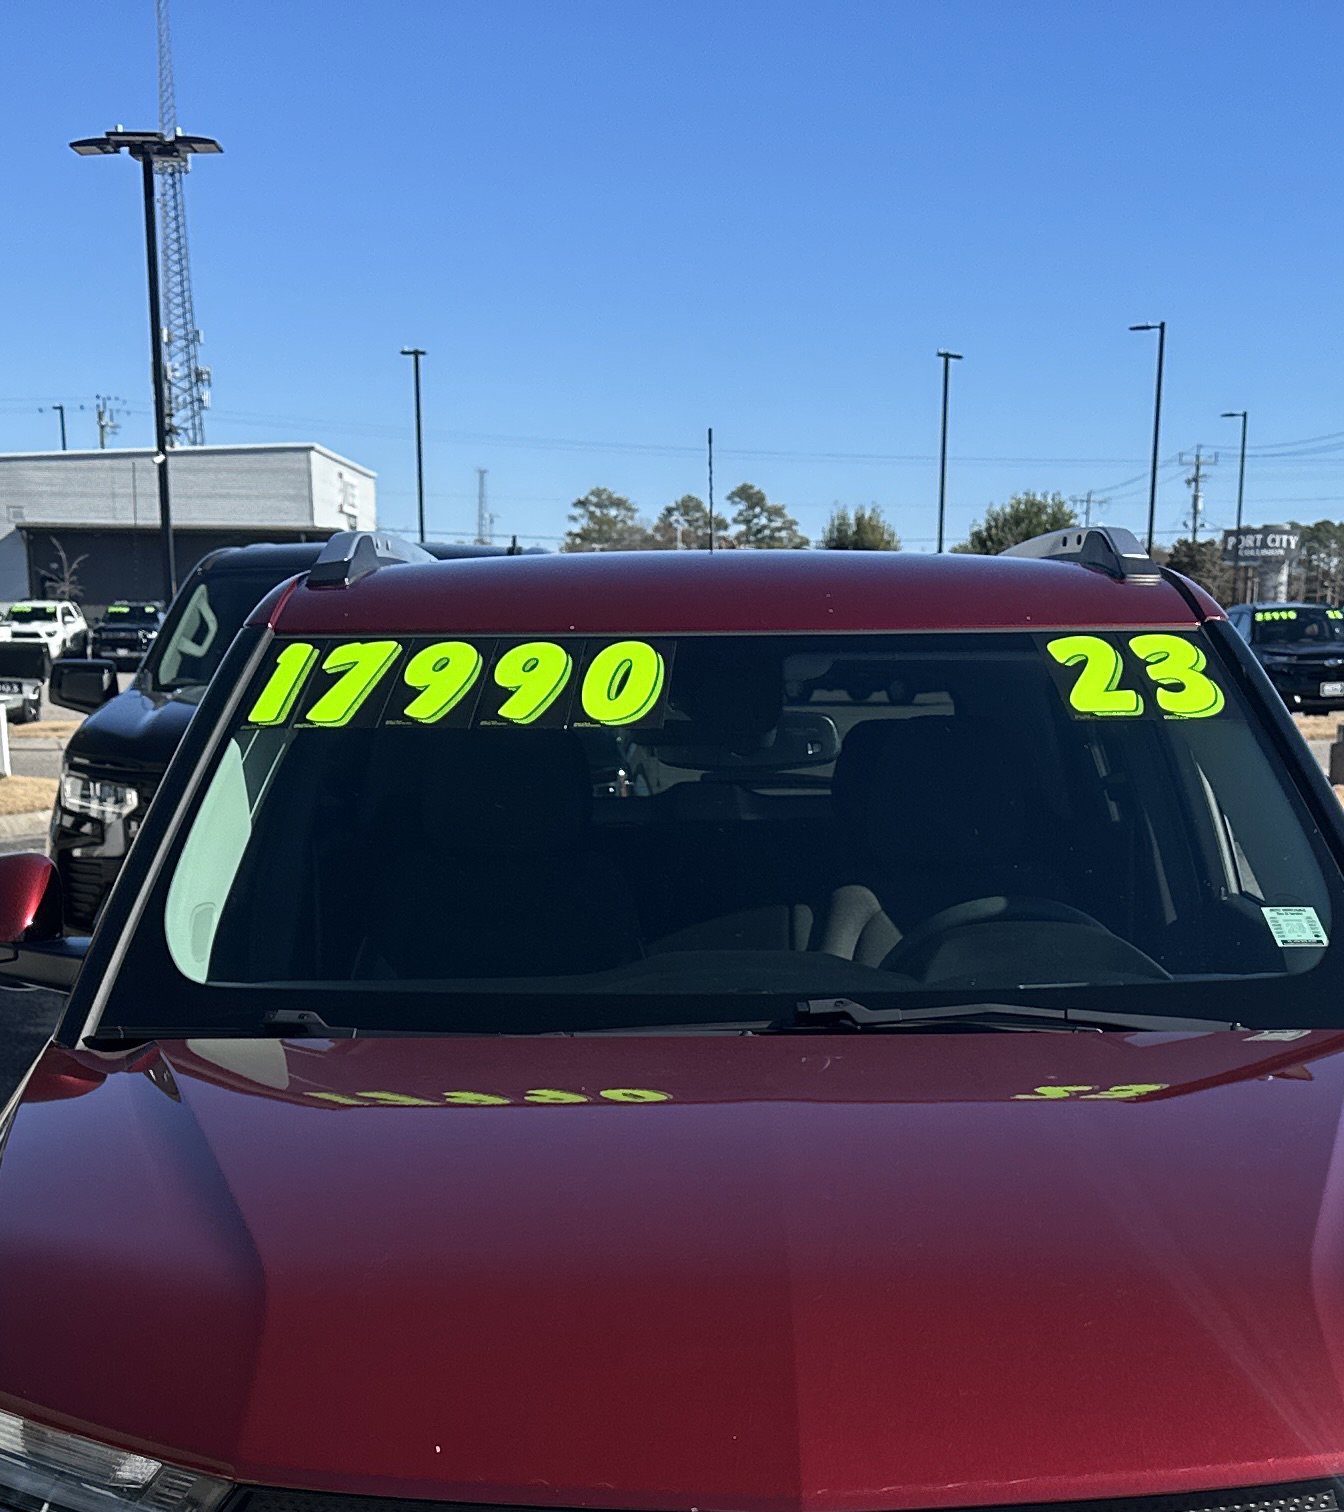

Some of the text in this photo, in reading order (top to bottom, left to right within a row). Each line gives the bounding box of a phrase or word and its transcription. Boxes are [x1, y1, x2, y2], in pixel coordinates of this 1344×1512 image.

[1227, 533, 1300, 550] PORT CITY
[247, 634, 1225, 728] 17990 23
